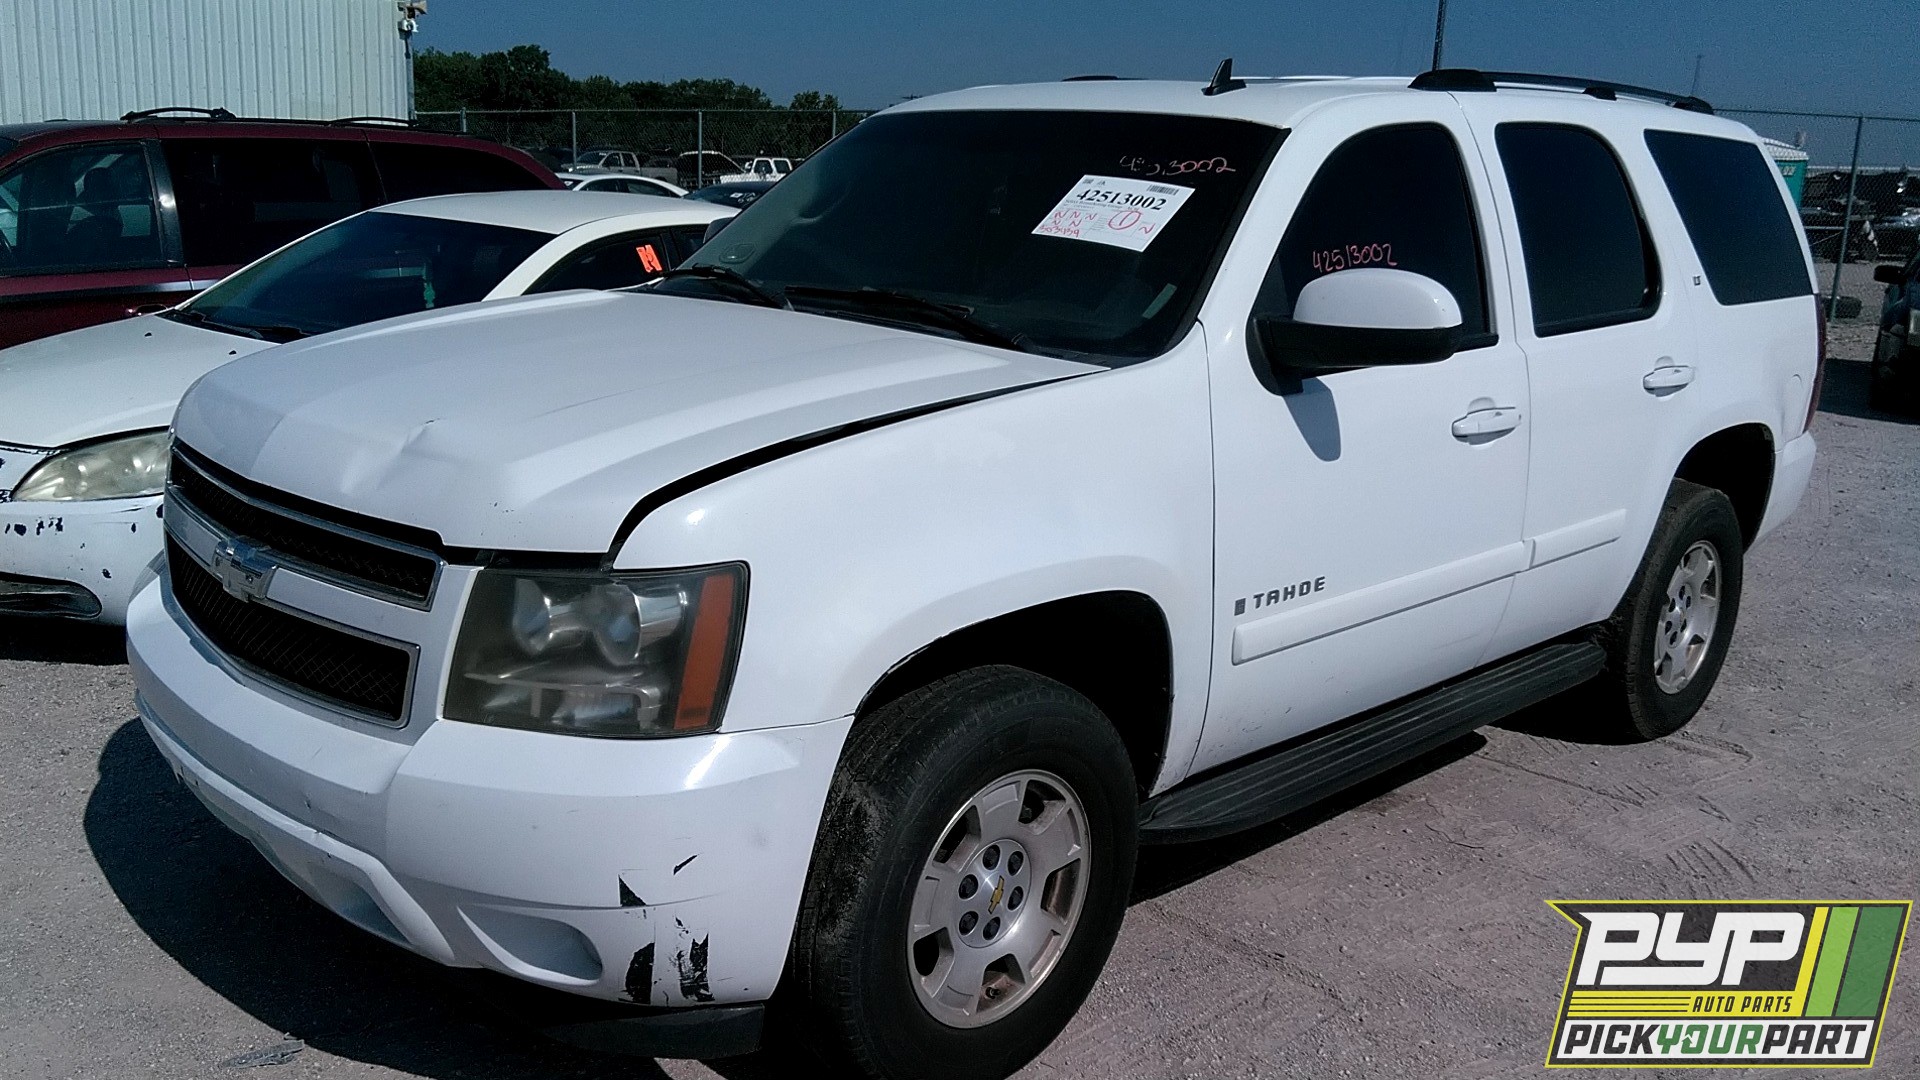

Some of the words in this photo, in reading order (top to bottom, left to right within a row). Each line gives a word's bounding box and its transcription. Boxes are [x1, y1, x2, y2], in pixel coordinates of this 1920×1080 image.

[1077, 189, 1167, 211] 42513002
[1313, 243, 1398, 273] 42513002
[1253, 576, 1326, 609] TAHOE
